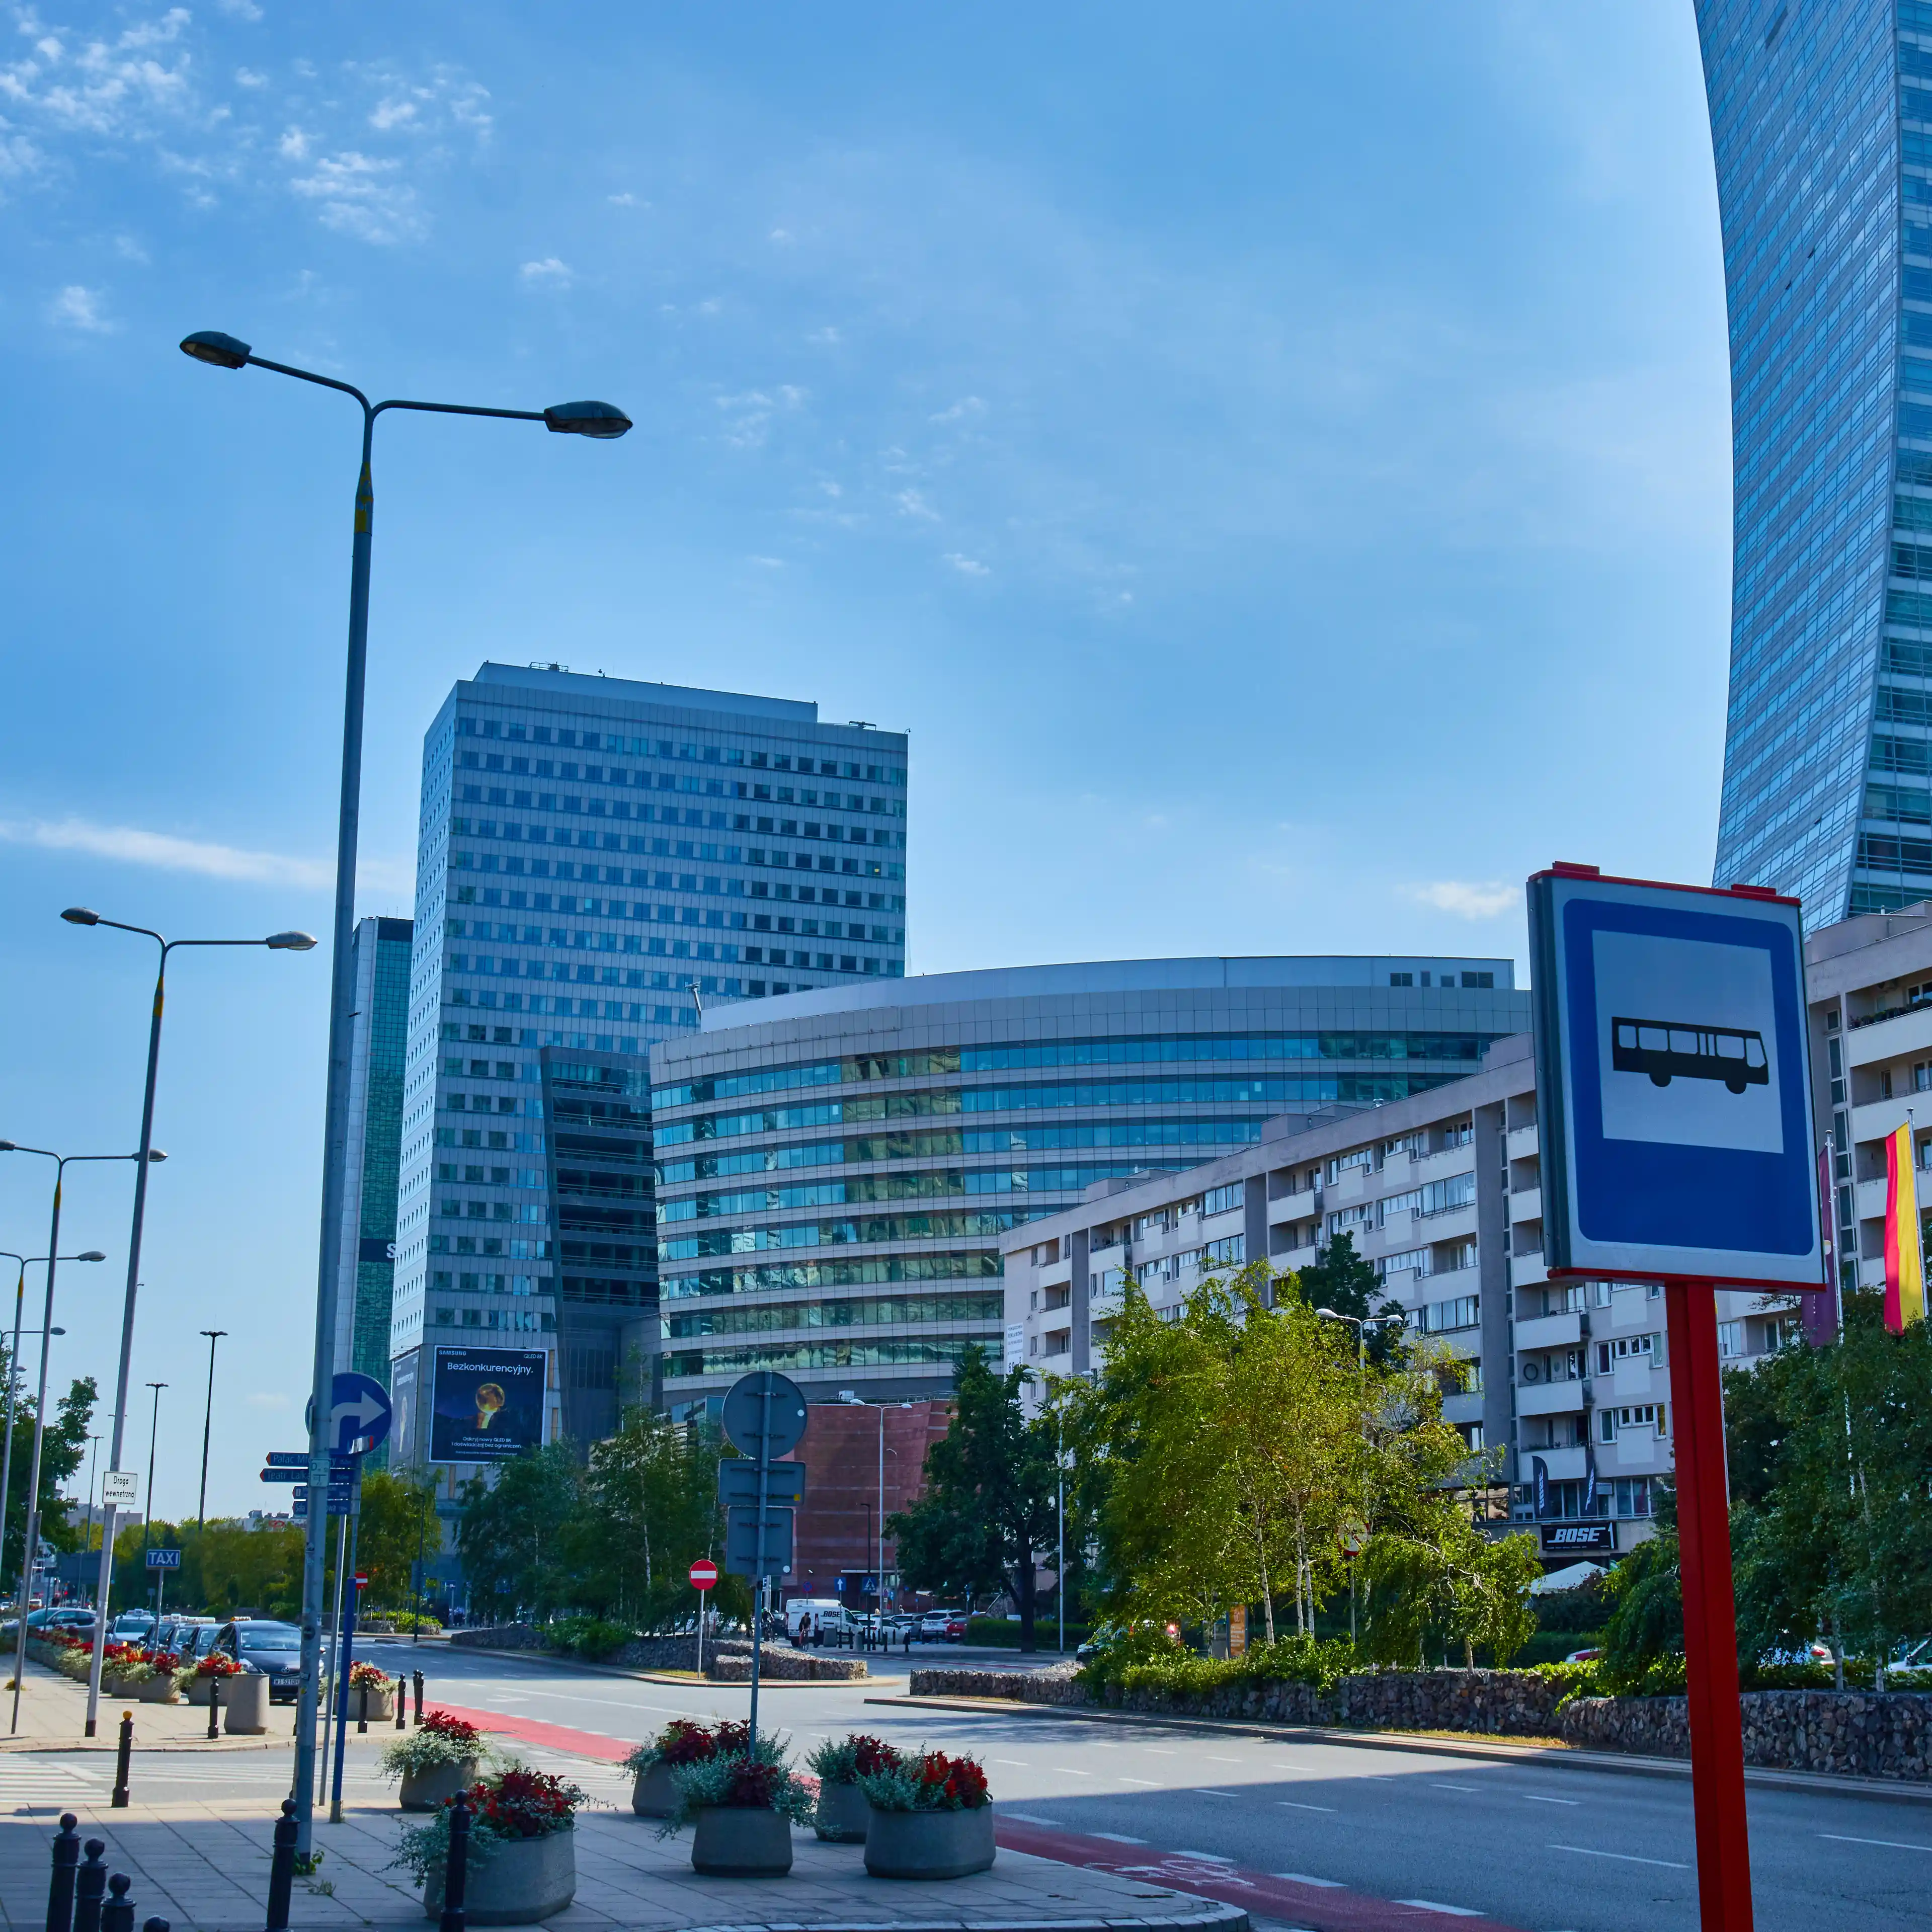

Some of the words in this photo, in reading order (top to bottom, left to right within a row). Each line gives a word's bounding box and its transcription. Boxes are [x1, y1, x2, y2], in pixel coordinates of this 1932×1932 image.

[447, 1362, 534, 1376] Bezkonkurencyjny.
[113, 1476, 129, 1487] Droga
[1547, 1527, 1606, 1543] BOSE
[149, 1552, 179, 1565] TAXI
